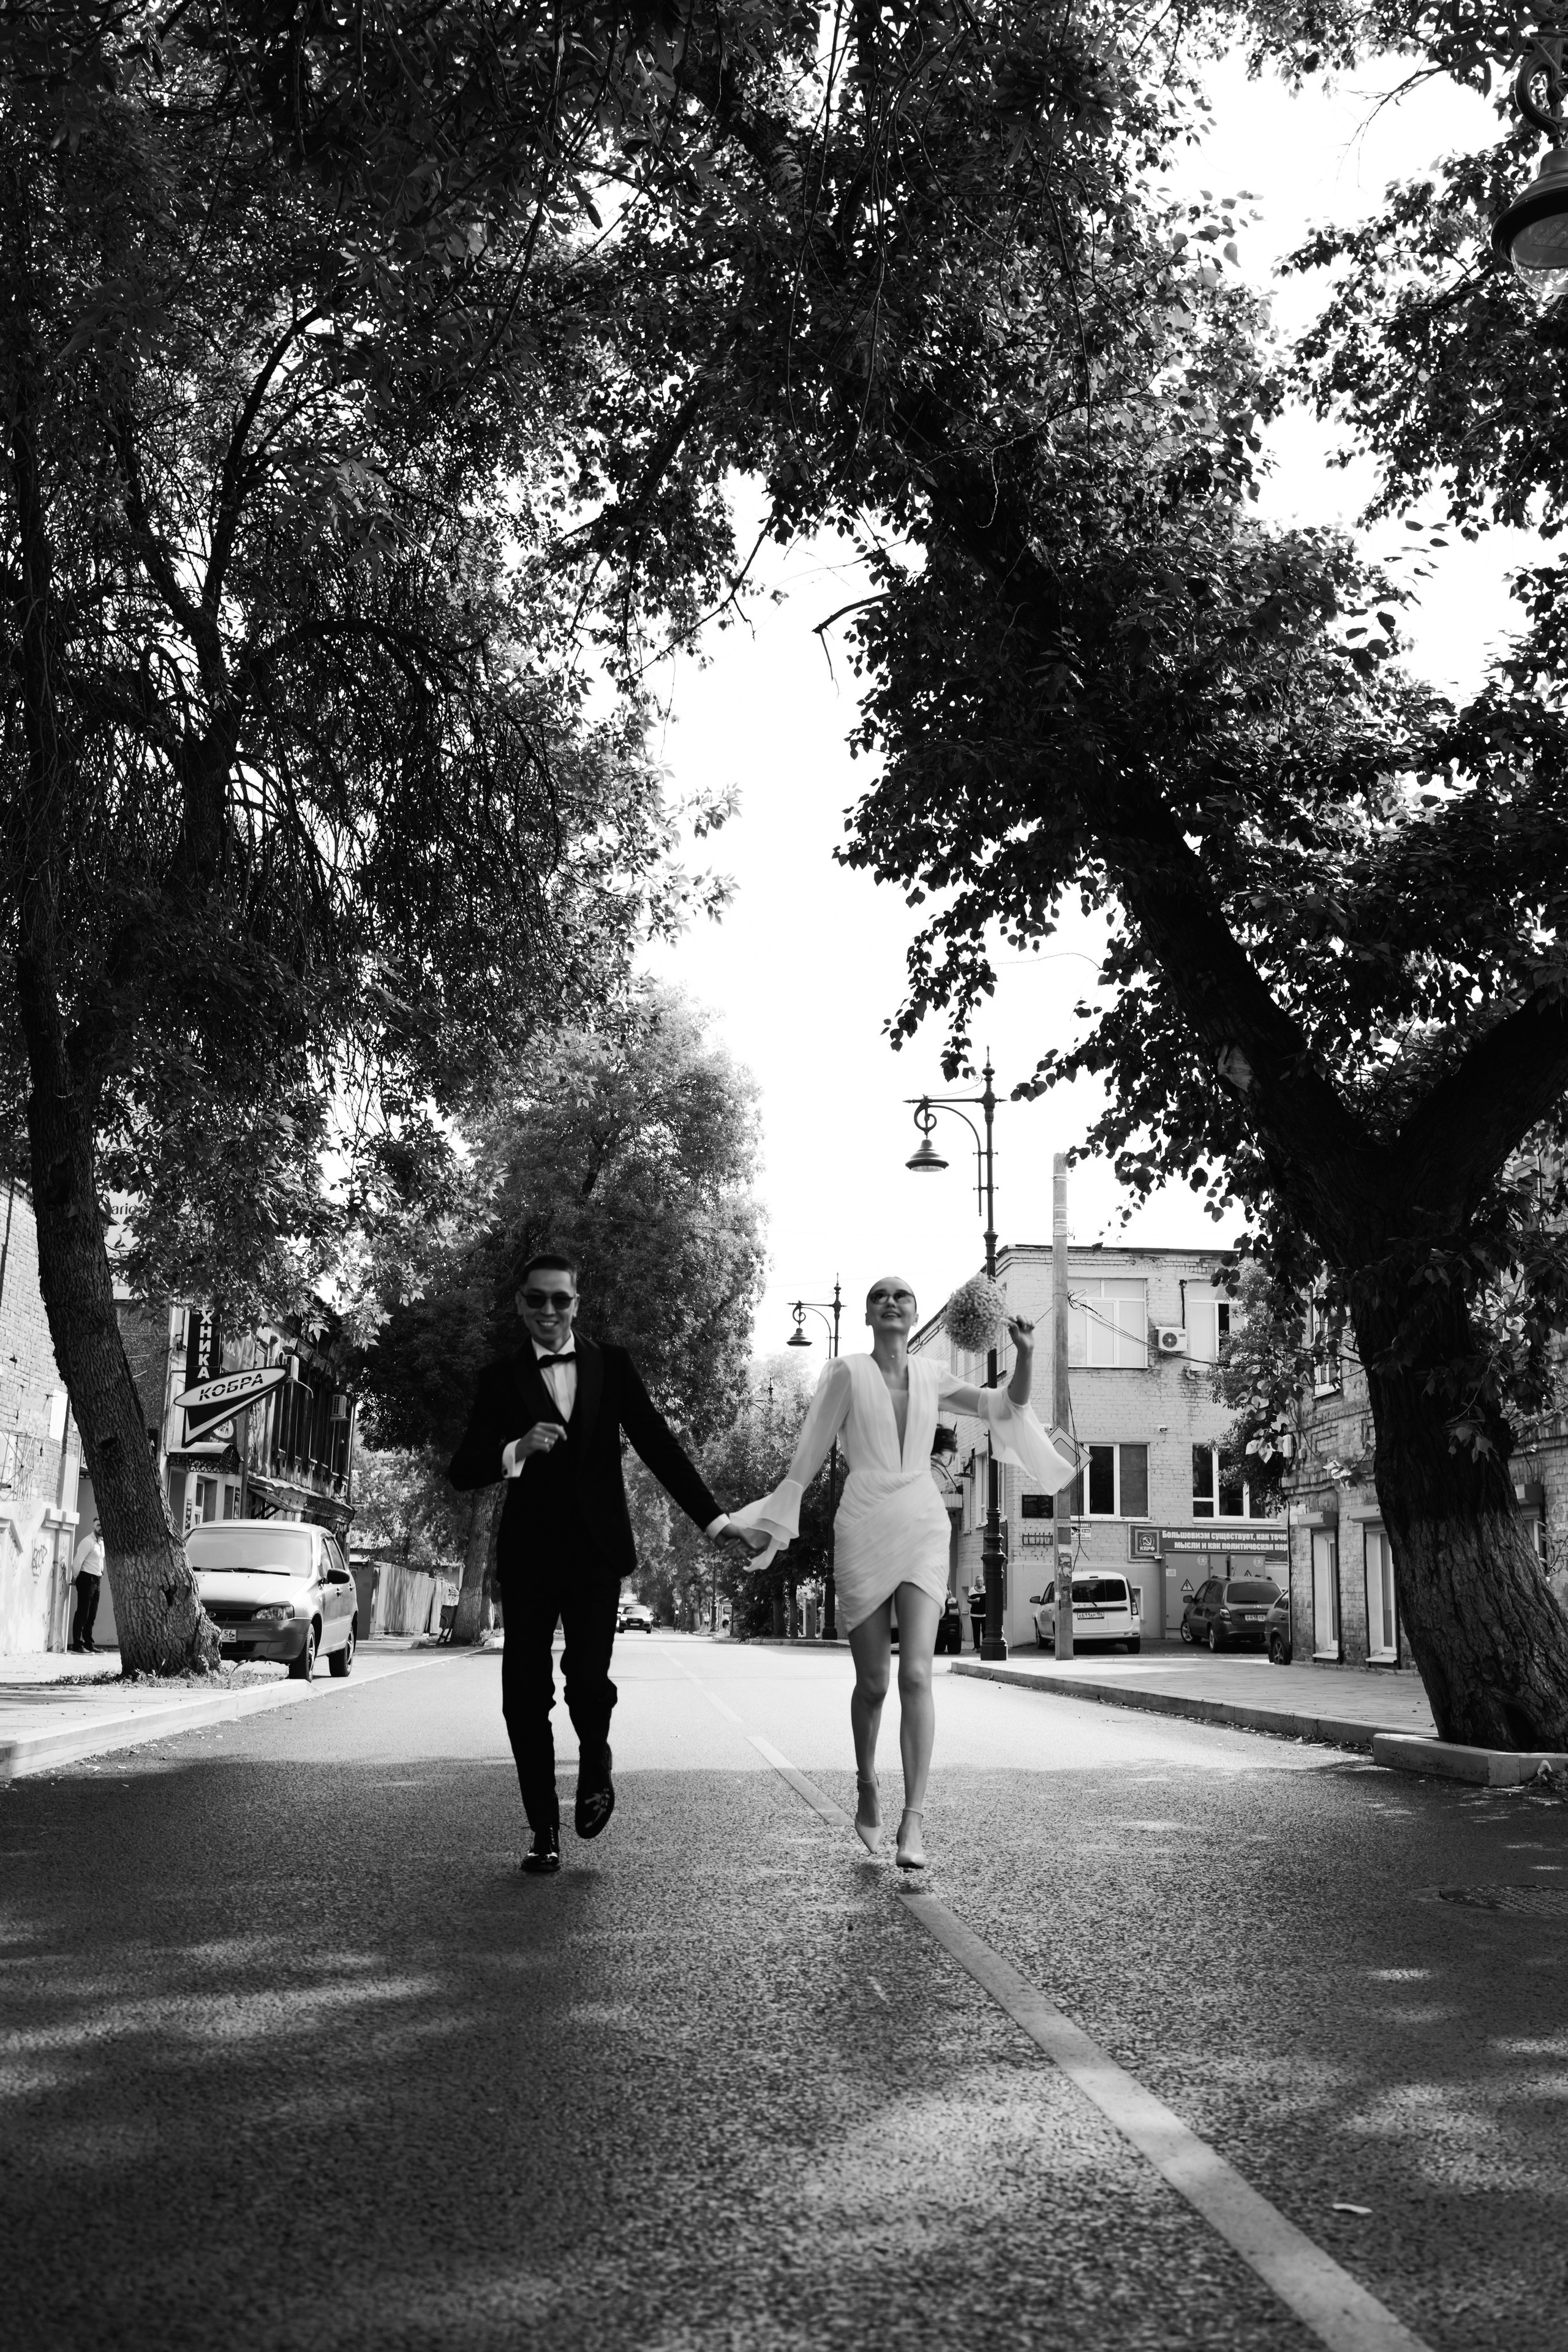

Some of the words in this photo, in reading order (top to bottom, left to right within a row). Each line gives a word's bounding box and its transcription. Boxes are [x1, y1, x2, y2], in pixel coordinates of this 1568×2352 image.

[198, 1373, 263, 1401] КОБРА
[1162, 1530, 1210, 1539] Большевизм
[1211, 1532, 1256, 1541] существует,
